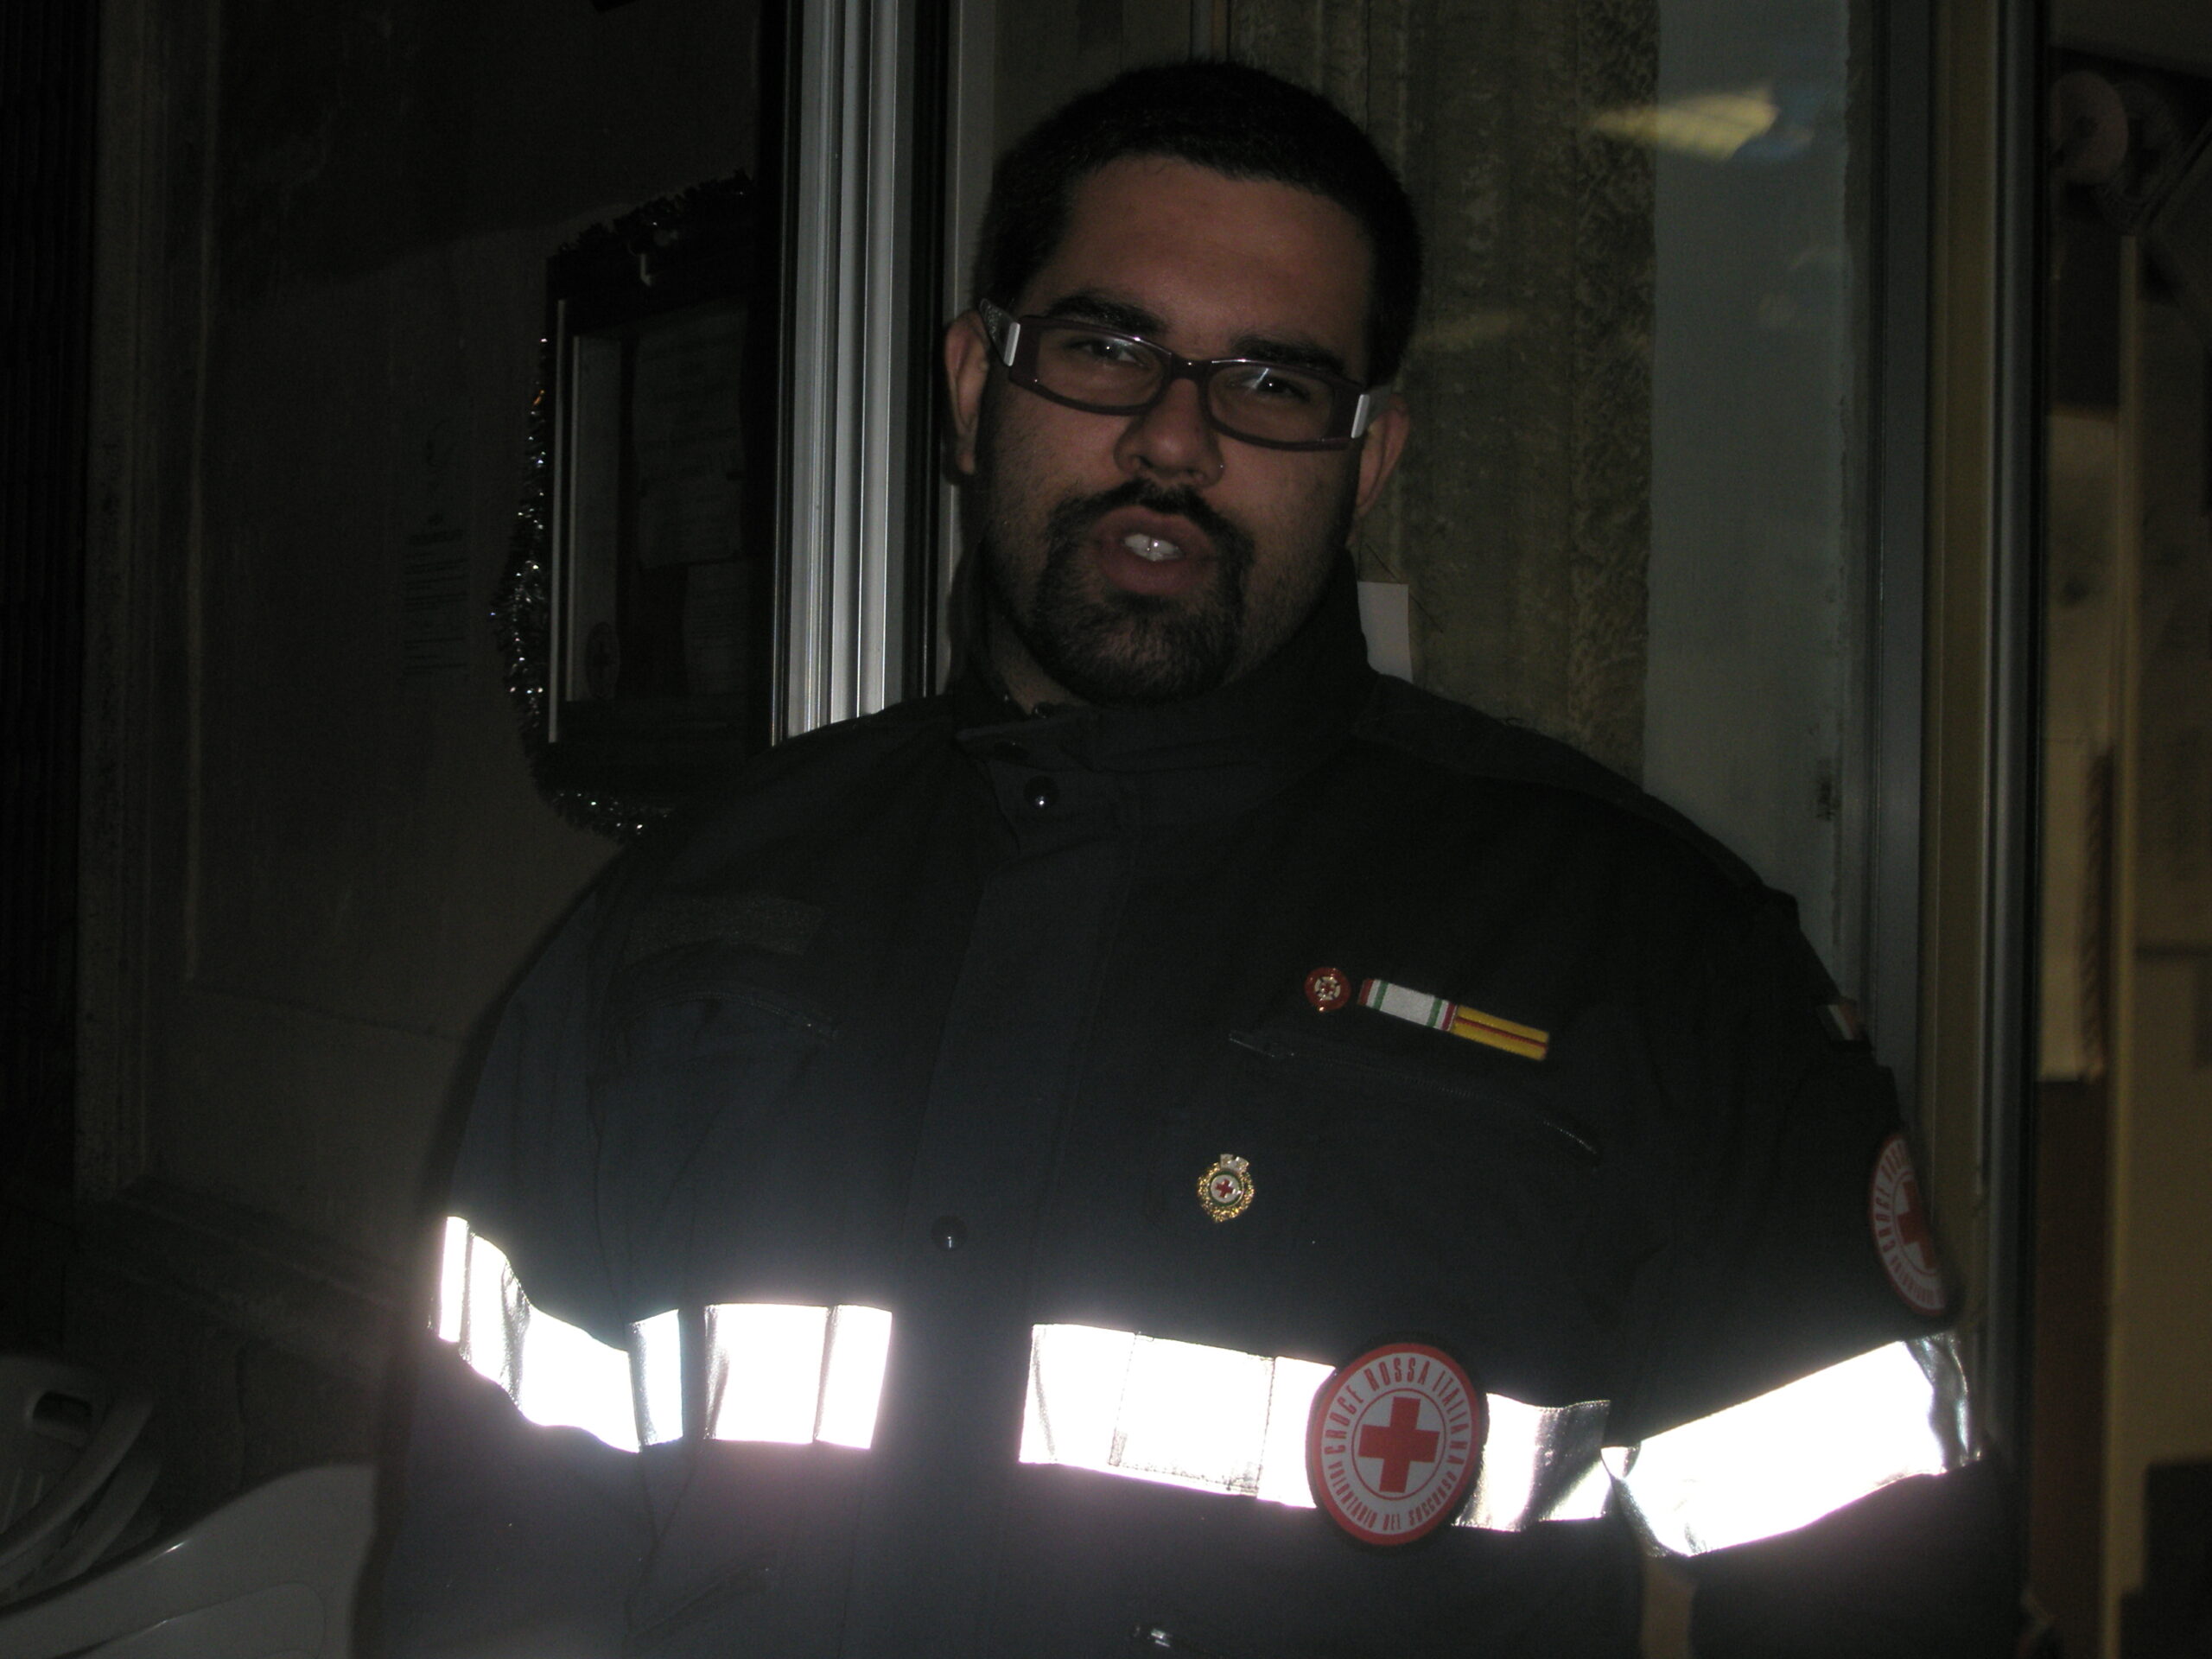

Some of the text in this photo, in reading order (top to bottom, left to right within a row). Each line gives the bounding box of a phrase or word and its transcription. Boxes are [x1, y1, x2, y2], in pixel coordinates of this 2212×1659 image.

[1325, 1357, 1469, 1465] CROCE ROSSA ITALIANA
[1327, 1459, 1458, 1531] VOLONTARIO DEL SOCCORSO
